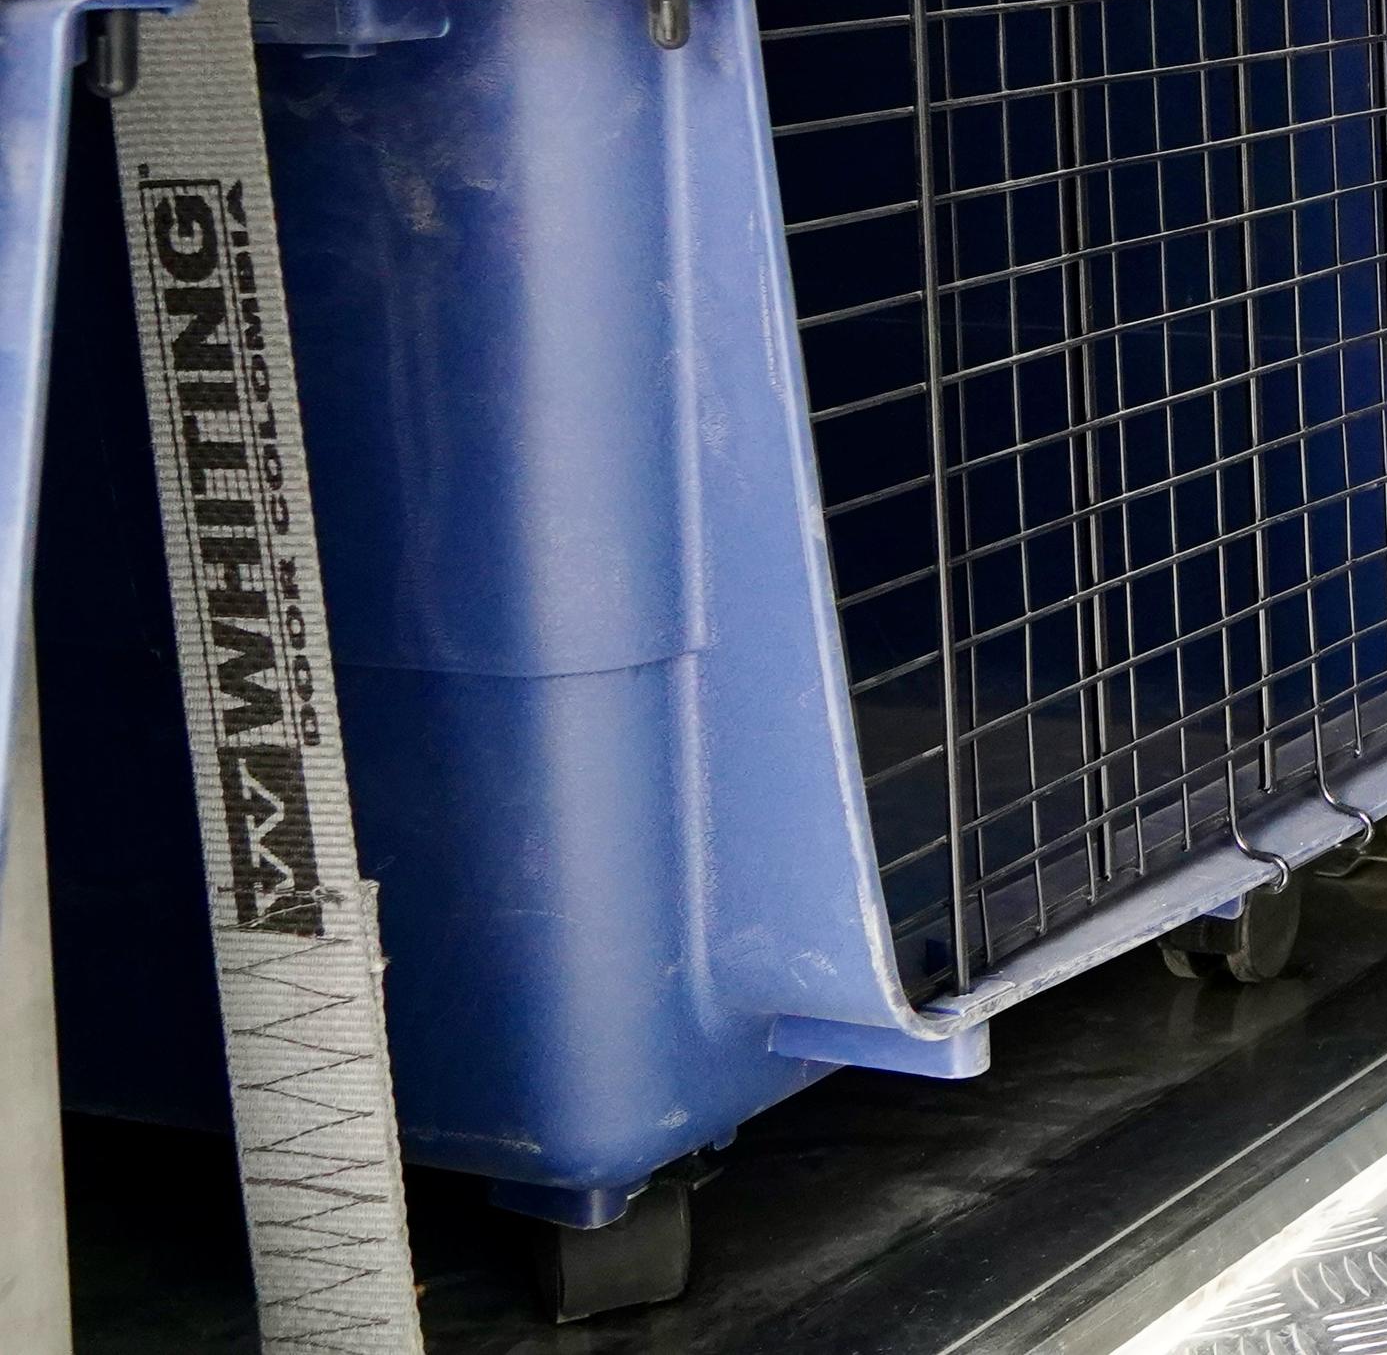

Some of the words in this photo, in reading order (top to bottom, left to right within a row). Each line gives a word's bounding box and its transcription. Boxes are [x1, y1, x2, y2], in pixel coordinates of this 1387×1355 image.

[153, 194, 284, 737] WHITING
[226, 179, 290, 536] COLOMBIA
[279, 554, 321, 747] DOOR
